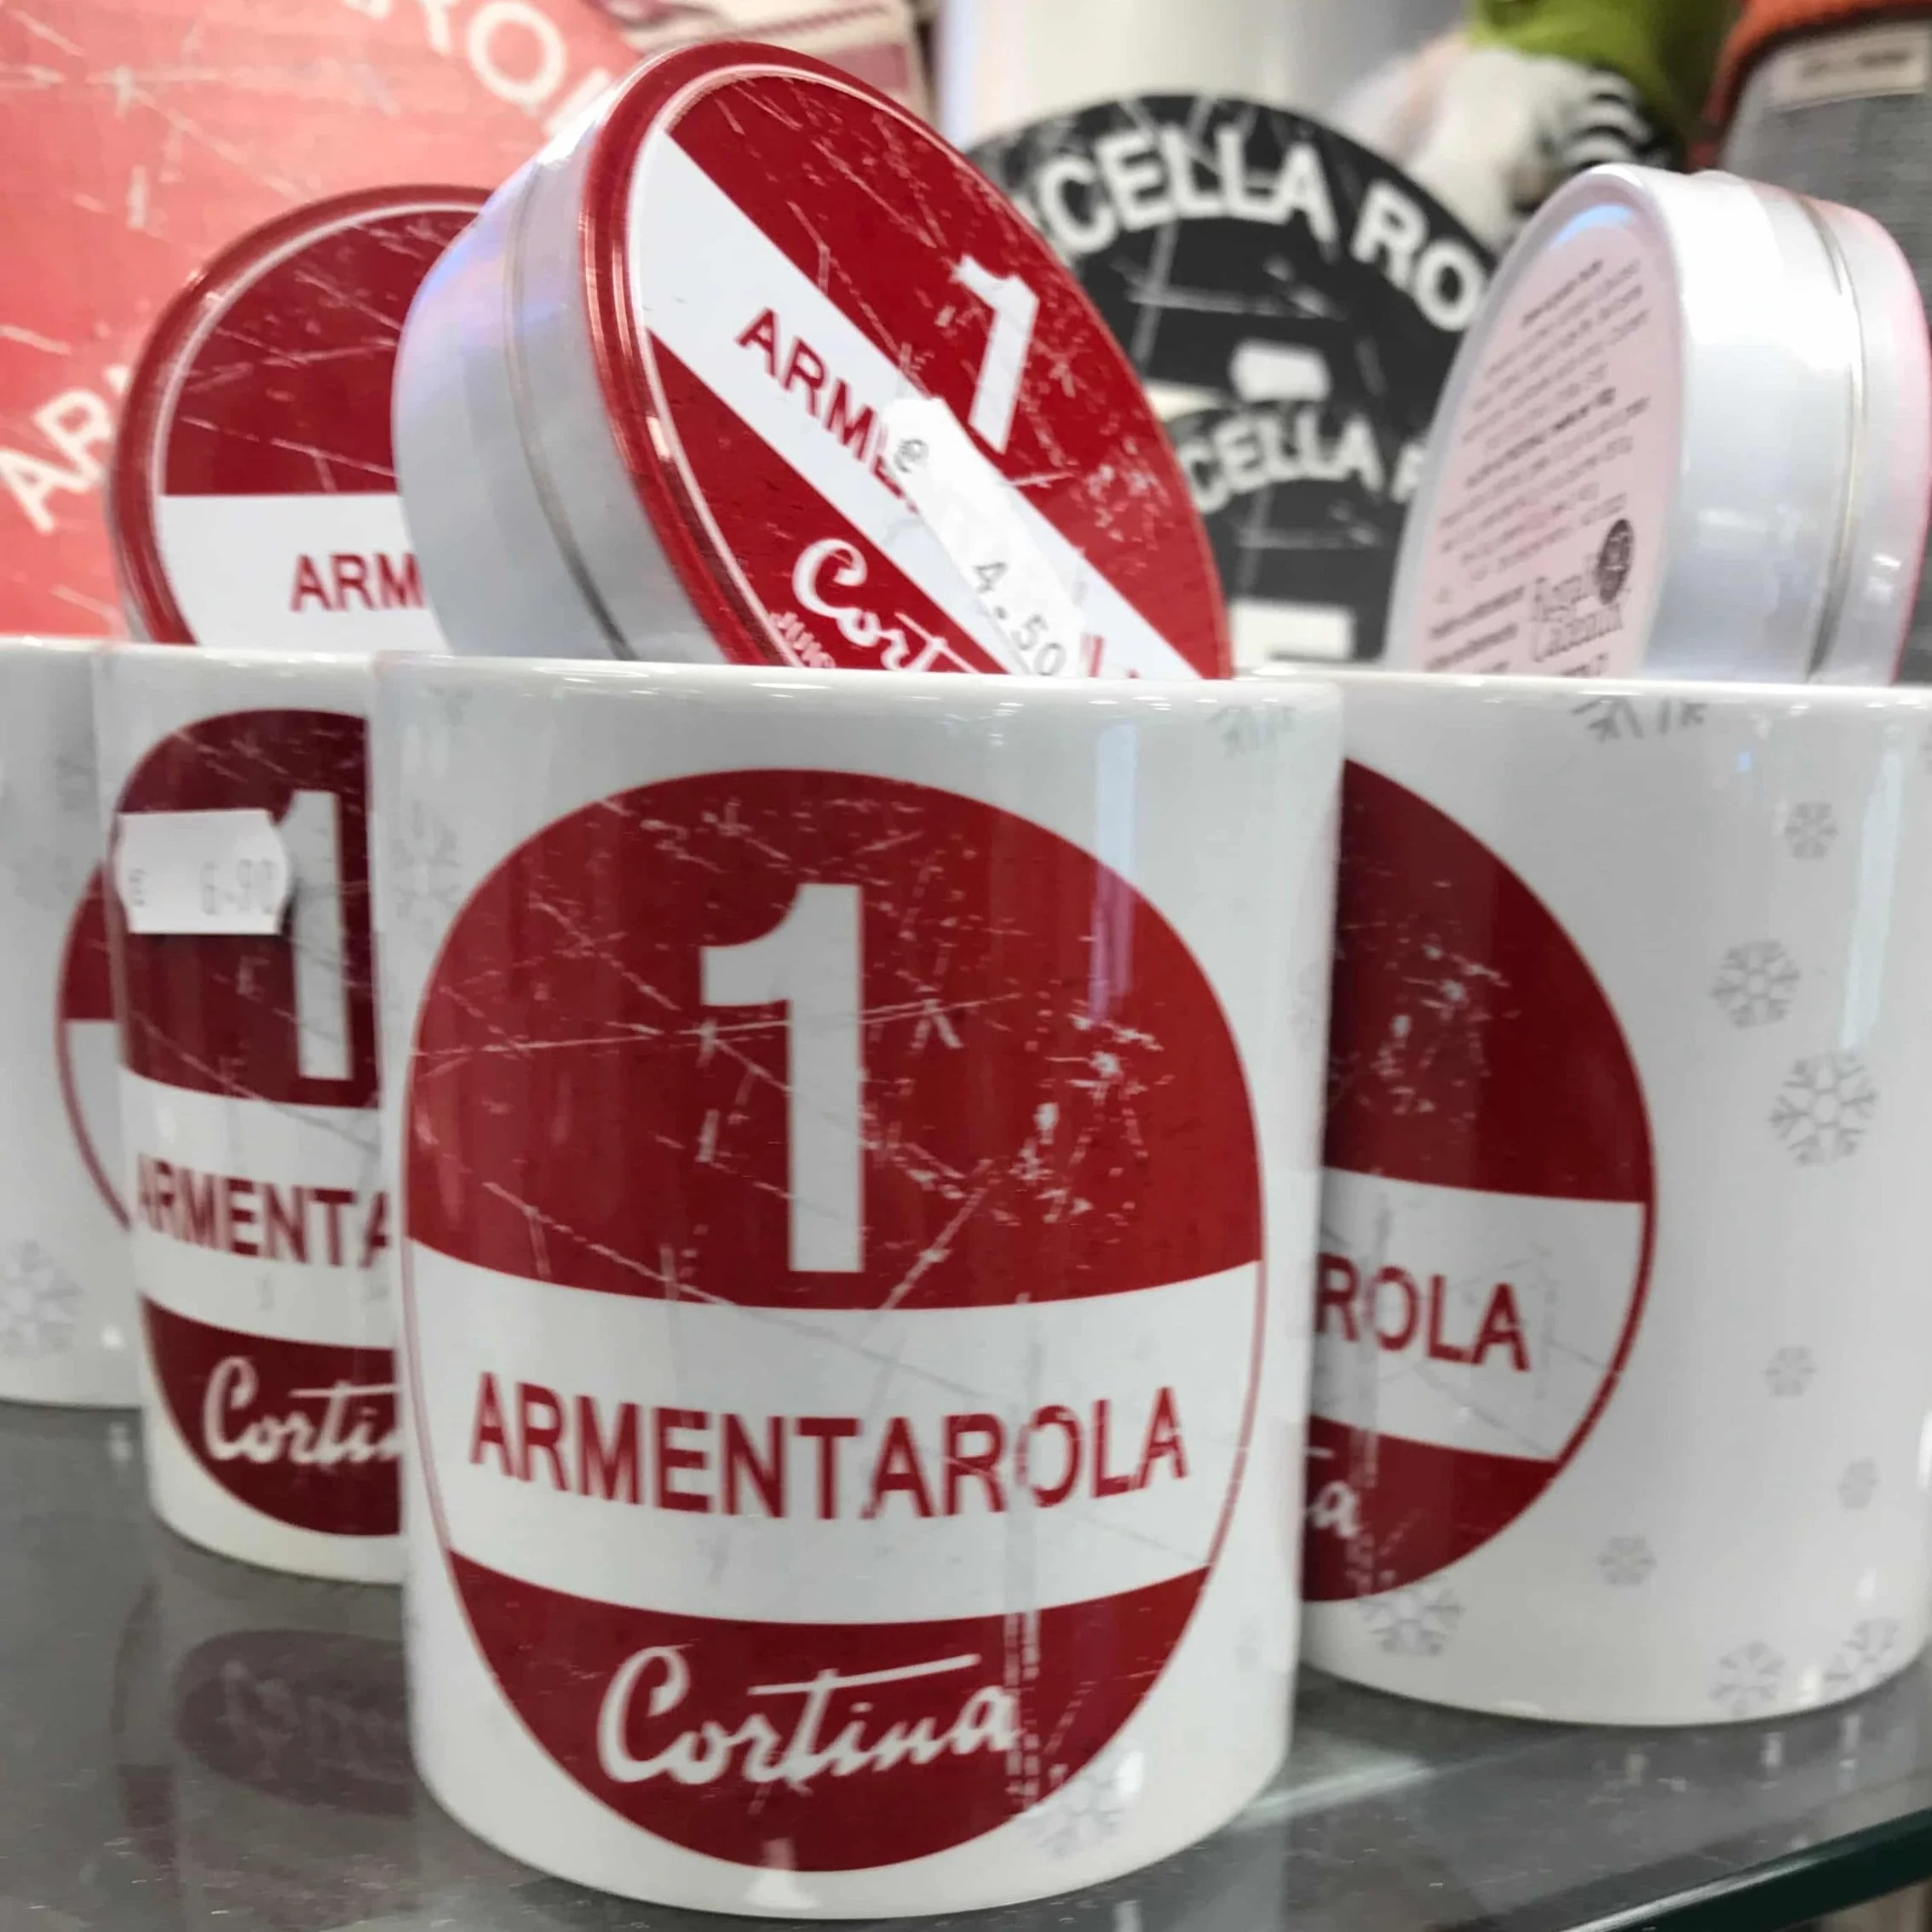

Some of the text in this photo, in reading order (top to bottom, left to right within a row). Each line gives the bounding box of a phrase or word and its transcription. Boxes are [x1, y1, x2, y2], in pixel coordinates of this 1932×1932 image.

[950, 255, 1038, 454] 1
[700, 883, 863, 1273] 1
[469, 1371, 1189, 1521] ARMENTAROLA
[598, 1644, 1026, 1789] Cortina
